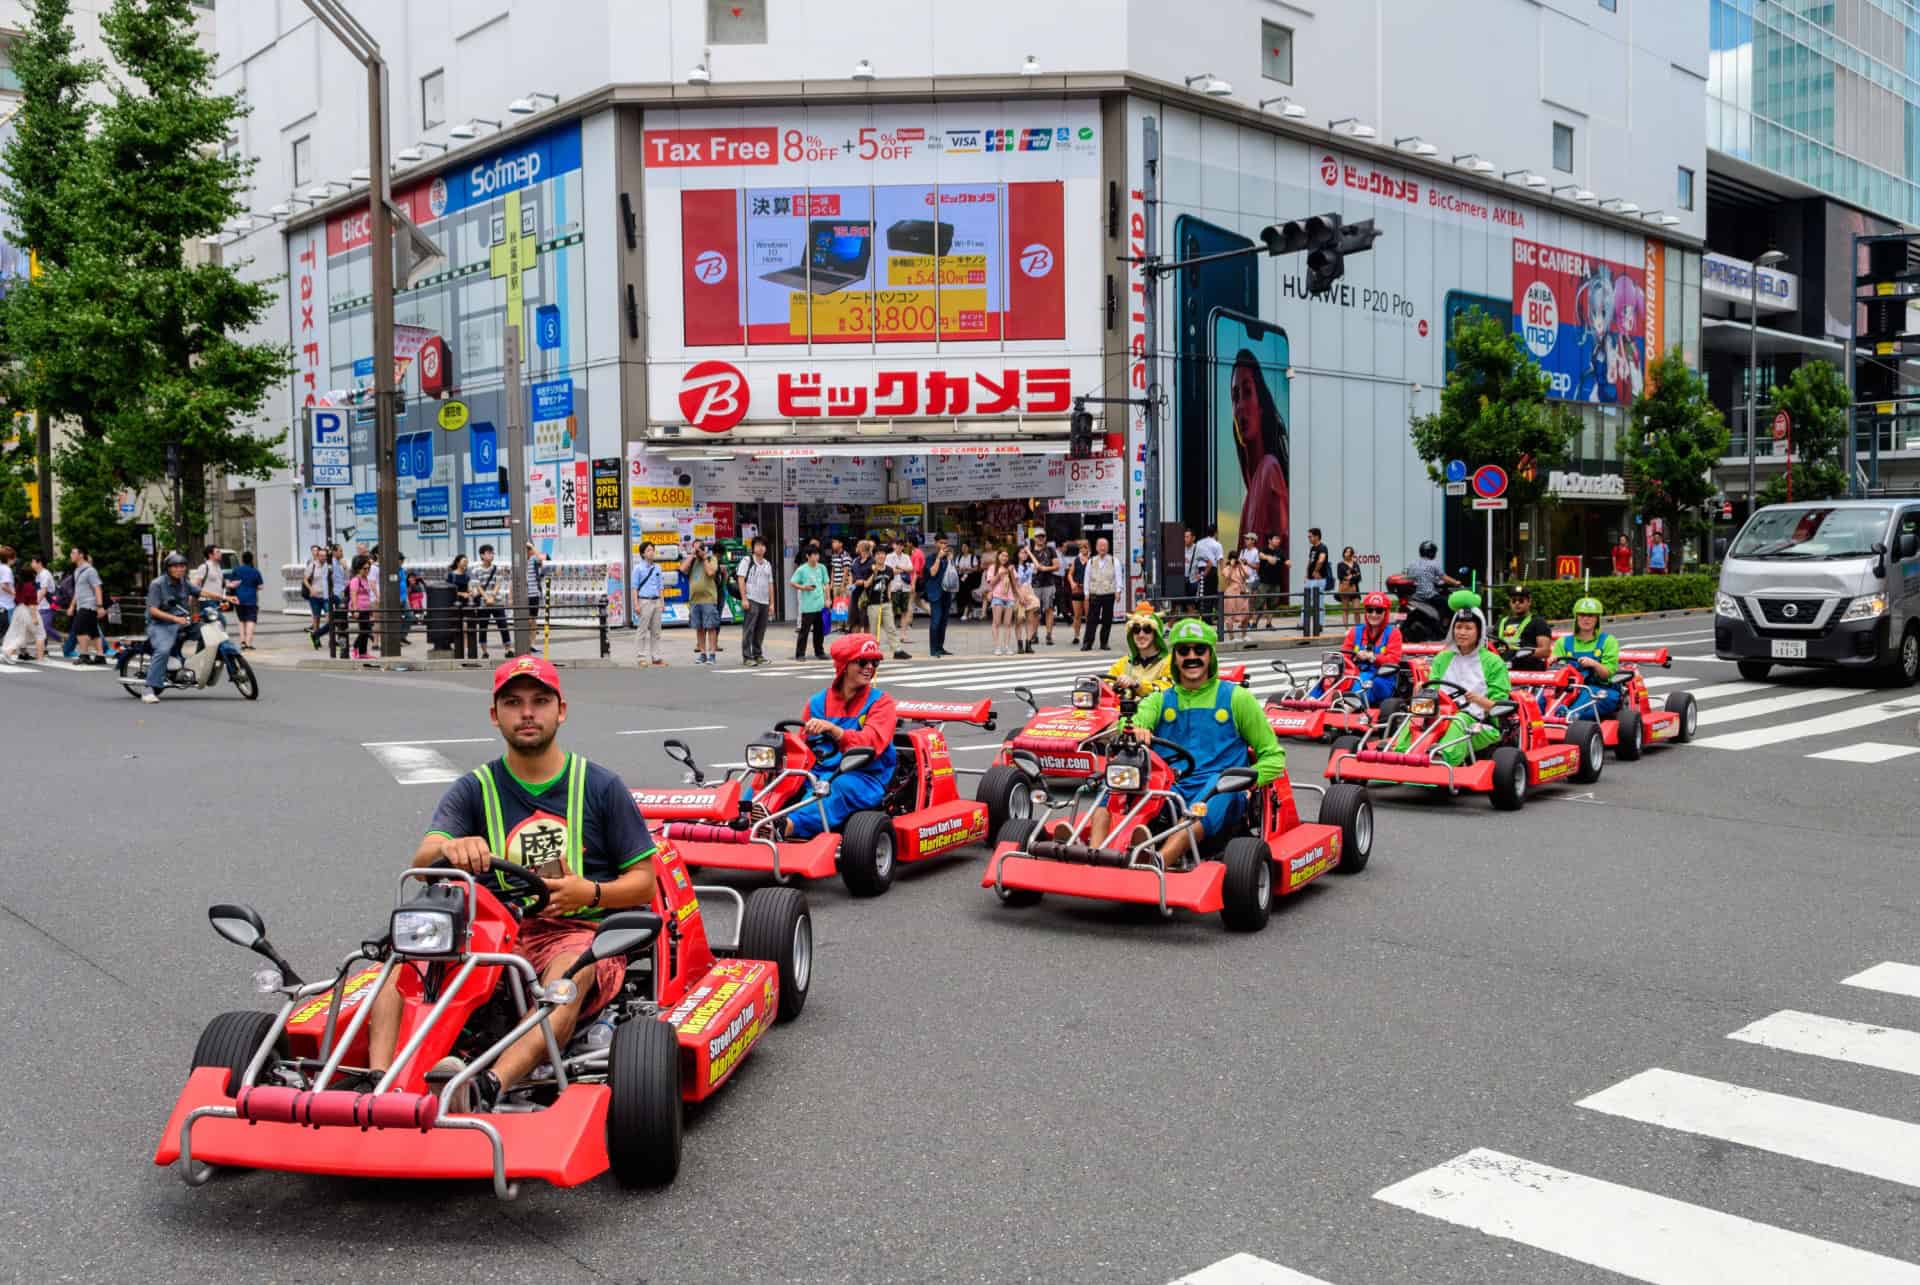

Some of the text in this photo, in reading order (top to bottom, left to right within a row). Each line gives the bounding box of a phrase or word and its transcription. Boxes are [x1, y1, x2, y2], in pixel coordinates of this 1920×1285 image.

[651, 138, 702, 161] Tax
[710, 136, 770, 160] Free
[783, 129, 803, 161] 8
[806, 148, 838, 161] OFF
[858, 127, 878, 160] 5
[880, 147, 912, 160] OFF
[951, 137, 977, 146] VISA
[471, 151, 541, 198] Sofmap
[1343, 166, 1419, 204] ビックカメラ
[752, 197, 790, 216] 決算
[1429, 190, 1525, 229] BicCamera AKIBA
[1514, 241, 1592, 279] BIC CAMERA
[299, 240, 316, 331] Tax
[1527, 287, 1553, 302] AKIBA
[1363, 288, 1389, 313] P20
[1392, 294, 1414, 318] Pro
[1528, 301, 1553, 326] BIC
[1646, 242, 1657, 360] KANBUNDO
[1527, 327, 1554, 350] map
[777, 367, 1071, 417] ビックカメラ
[315, 413, 341, 443] P
[319, 467, 342, 475] UDX
[1071, 460, 1104, 480] 8 5
[562, 479, 575, 528] 決算
[596, 485, 619, 497] OPEN
[596, 496, 619, 508] SALE
[1040, 754, 1090, 769] riCar.com
[919, 829, 969, 853] MariCar.com
[678, 982, 743, 1034] MariCar.com
[709, 1003, 755, 1059] Street Kart Tour
[709, 1019, 761, 1084] MariCar.com
